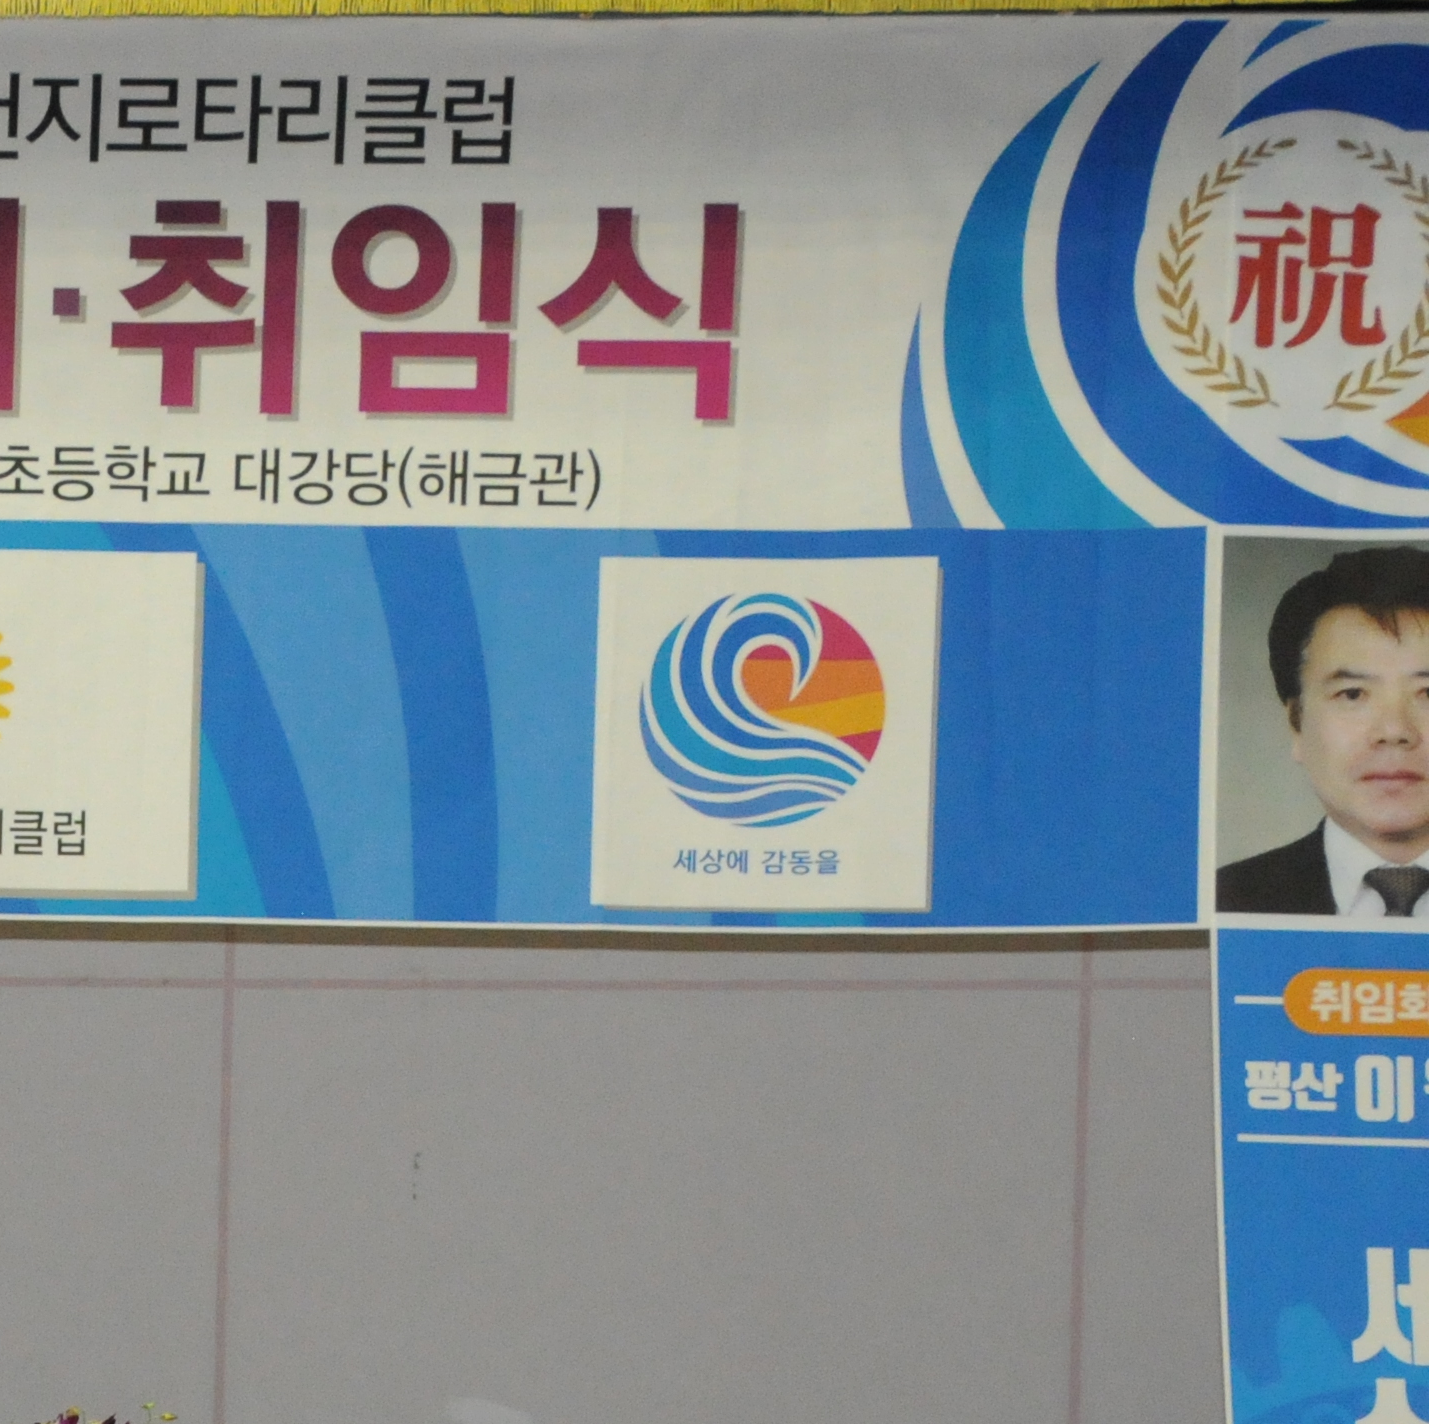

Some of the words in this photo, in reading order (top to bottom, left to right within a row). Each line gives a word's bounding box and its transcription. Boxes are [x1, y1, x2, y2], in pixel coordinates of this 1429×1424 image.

[1230, 201, 1387, 348] 祝
[233, 446, 602, 511] 대강당(해금관)
[673, 849, 749, 874] 세상에
[761, 849, 840, 876] 감동을
[1244, 1060, 1345, 1112] 평산
[1354, 1054, 1429, 1123] 이
